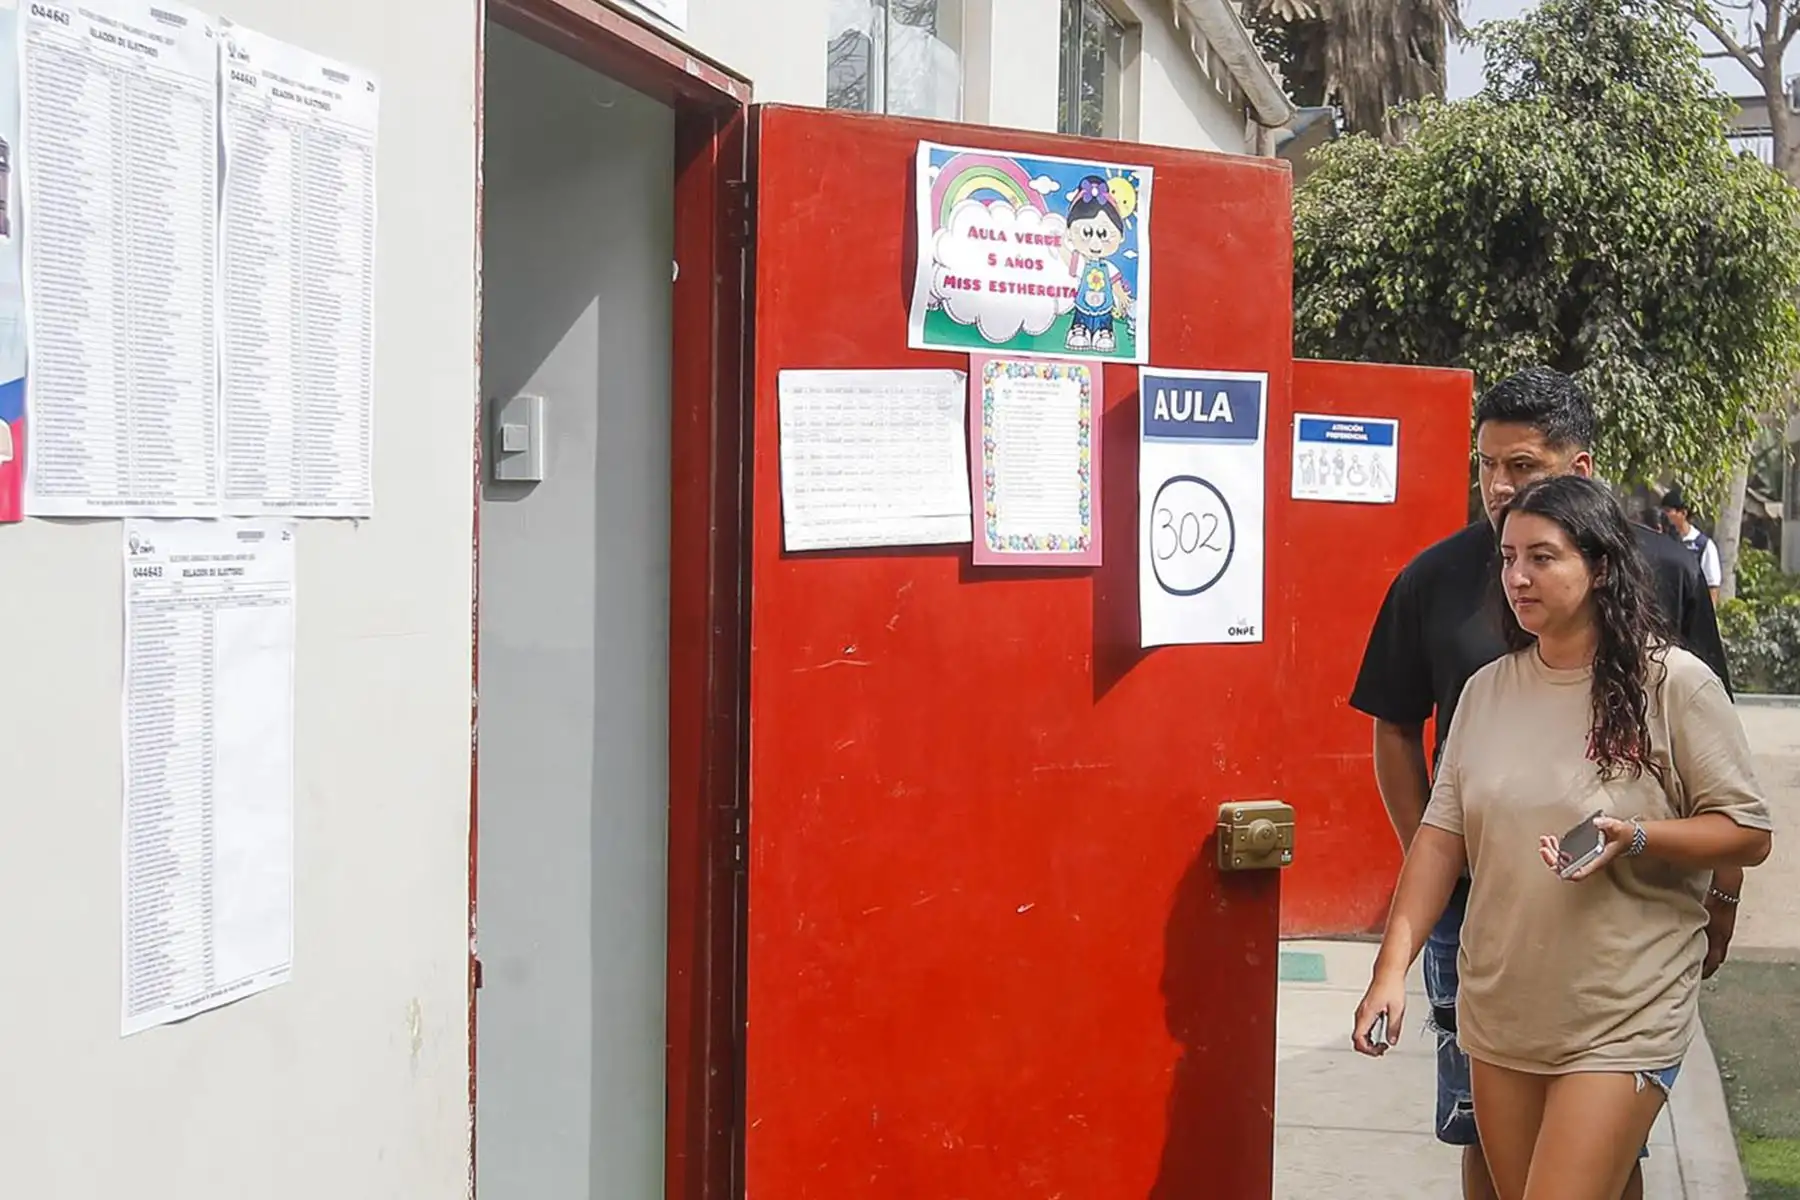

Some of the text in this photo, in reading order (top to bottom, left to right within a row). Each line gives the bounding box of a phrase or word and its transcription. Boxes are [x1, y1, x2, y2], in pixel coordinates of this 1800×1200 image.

[968, 226, 1062, 247] AULA VERDE
[988, 253, 1044, 271] 5 AÑOS
[943, 275, 1078, 298] MISS ESTHERCITA
[1153, 388, 1233, 423] AULA
[1157, 508, 1222, 560] 302
[1228, 626, 1255, 636] ONPE
